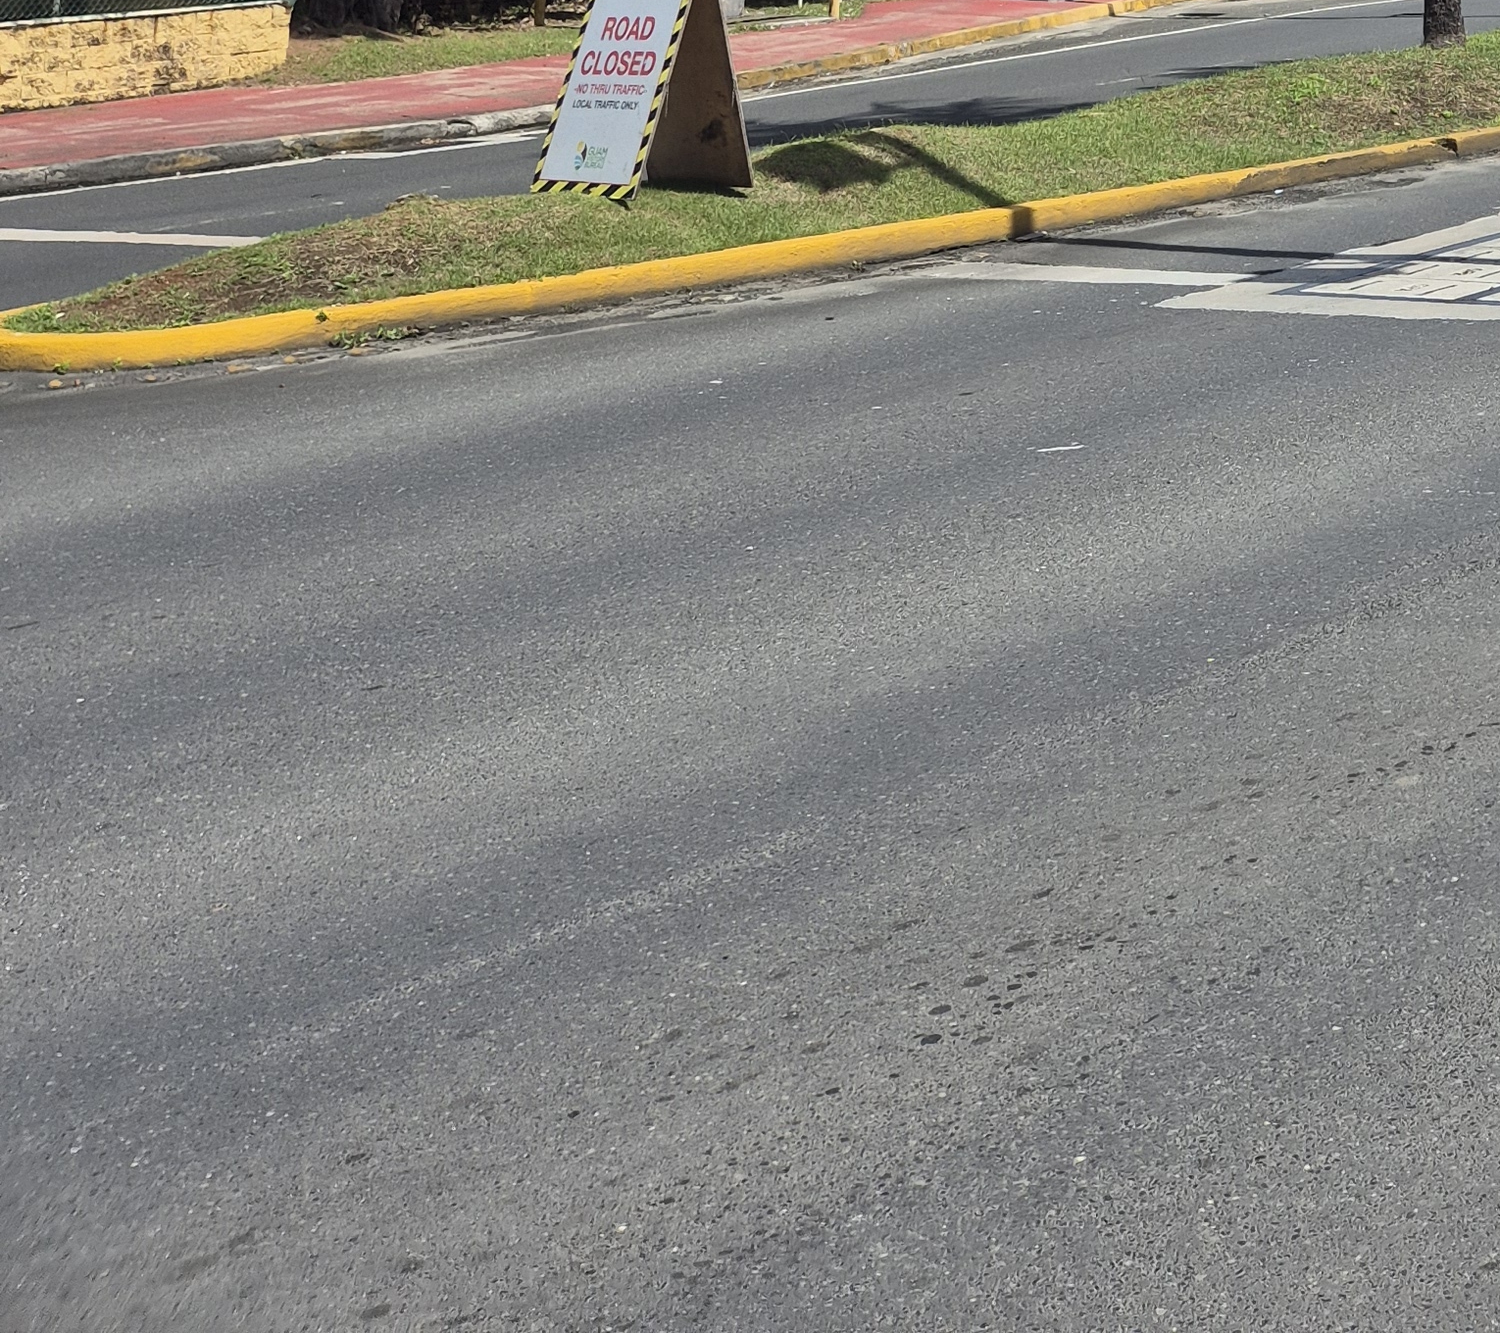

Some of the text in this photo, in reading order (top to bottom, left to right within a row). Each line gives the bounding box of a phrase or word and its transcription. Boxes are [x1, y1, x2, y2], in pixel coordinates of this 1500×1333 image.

[600, 16, 656, 41] ROAD
[580, 50, 657, 75] CLOSED
[590, 83, 611, 95] THRU
[572, 99, 639, 110] LOCAL TRAFFIC ONLY
[588, 146, 608, 155] GUAM
